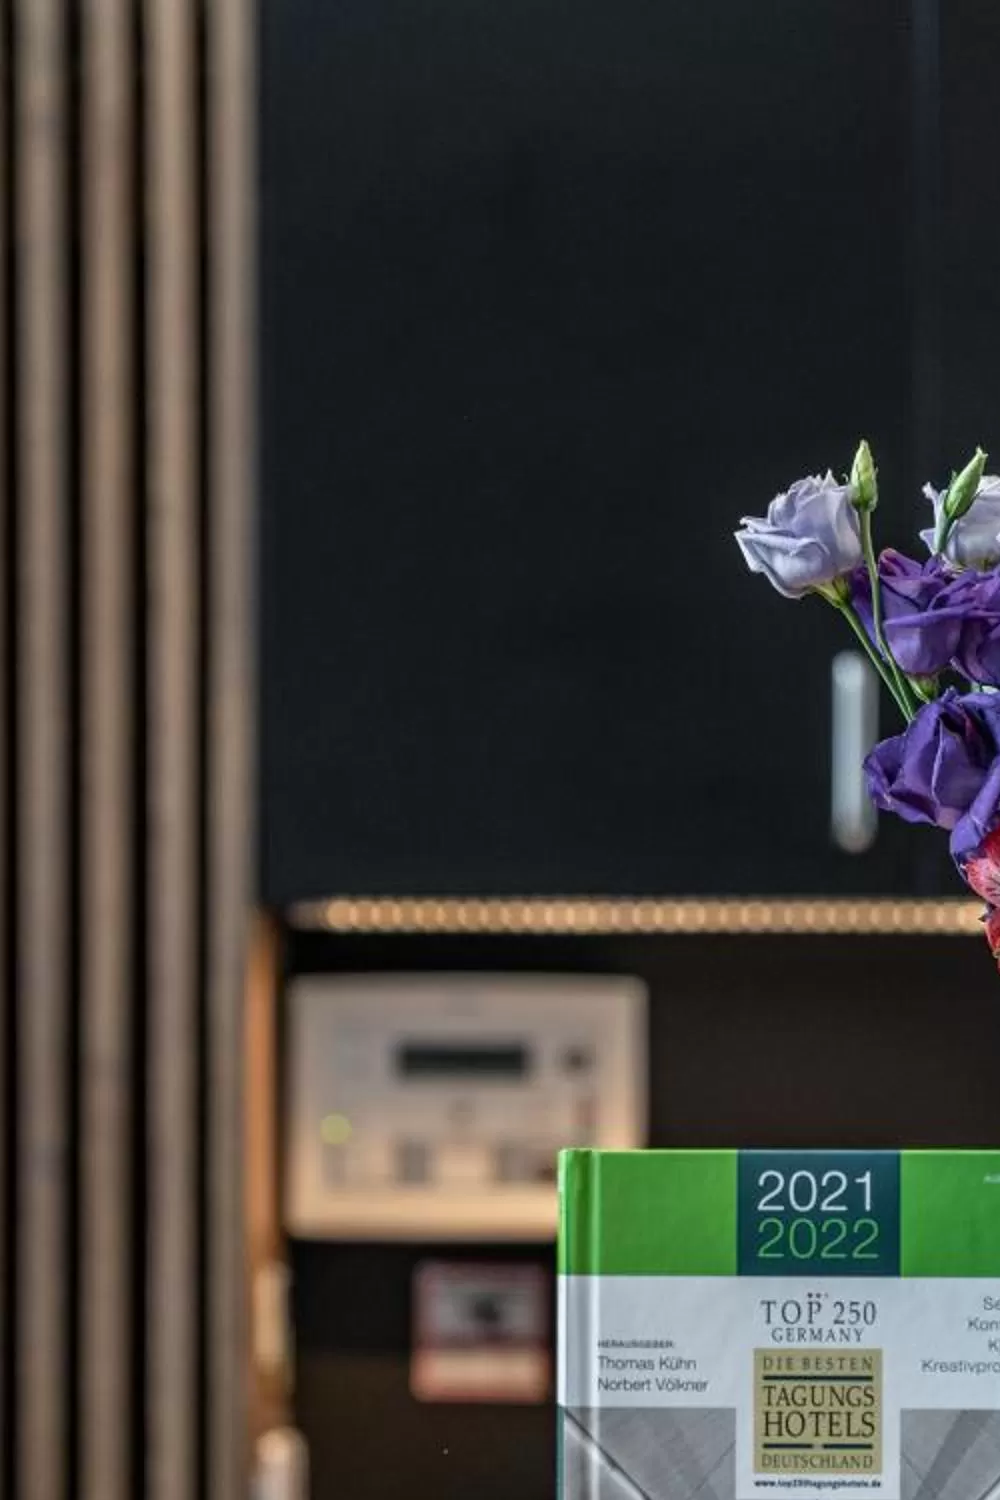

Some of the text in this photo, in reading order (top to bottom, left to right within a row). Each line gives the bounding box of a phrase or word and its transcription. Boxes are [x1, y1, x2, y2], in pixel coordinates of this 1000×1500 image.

[757, 1169, 871, 1212] 2021
[757, 1217, 879, 1259] 2022
[760, 1299, 877, 1326] TOP 250
[771, 1327, 864, 1343] GERMANY
[598, 1354, 697, 1370] Thomas Kühn
[762, 1355, 874, 1371] DIE BESTEN
[598, 1377, 651, 1392] Norbert
[762, 1385, 875, 1408] TAGUNGS
[762, 1410, 876, 1438] HOTELS
[761, 1453, 873, 1469] DEUTSCHLAND
